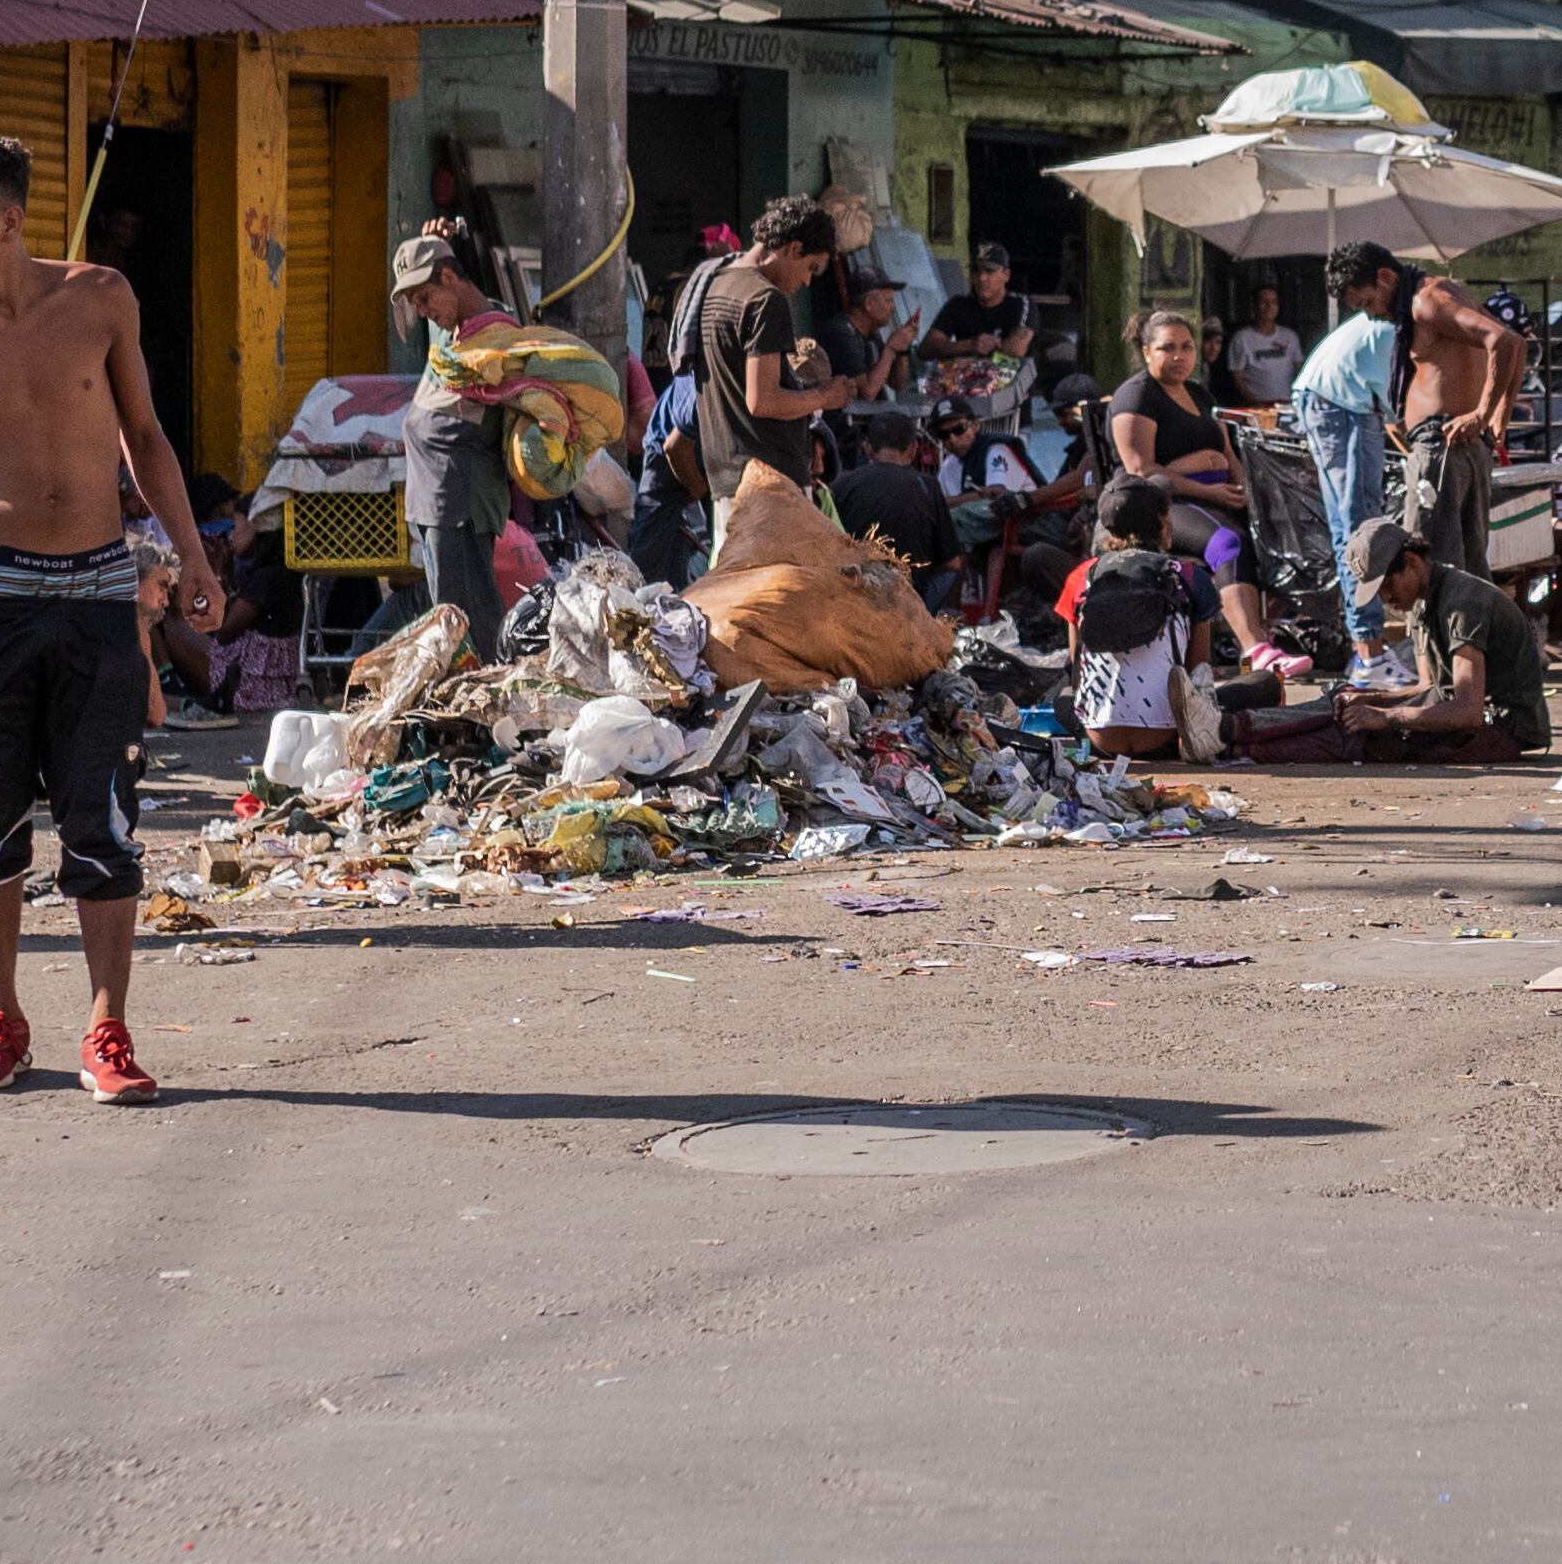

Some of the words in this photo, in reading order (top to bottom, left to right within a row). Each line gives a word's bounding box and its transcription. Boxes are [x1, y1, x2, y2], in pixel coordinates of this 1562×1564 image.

[693, 27, 782, 64] PASTUSO
[14, 555, 74, 569] newboat
[89, 544, 127, 564] newboa
